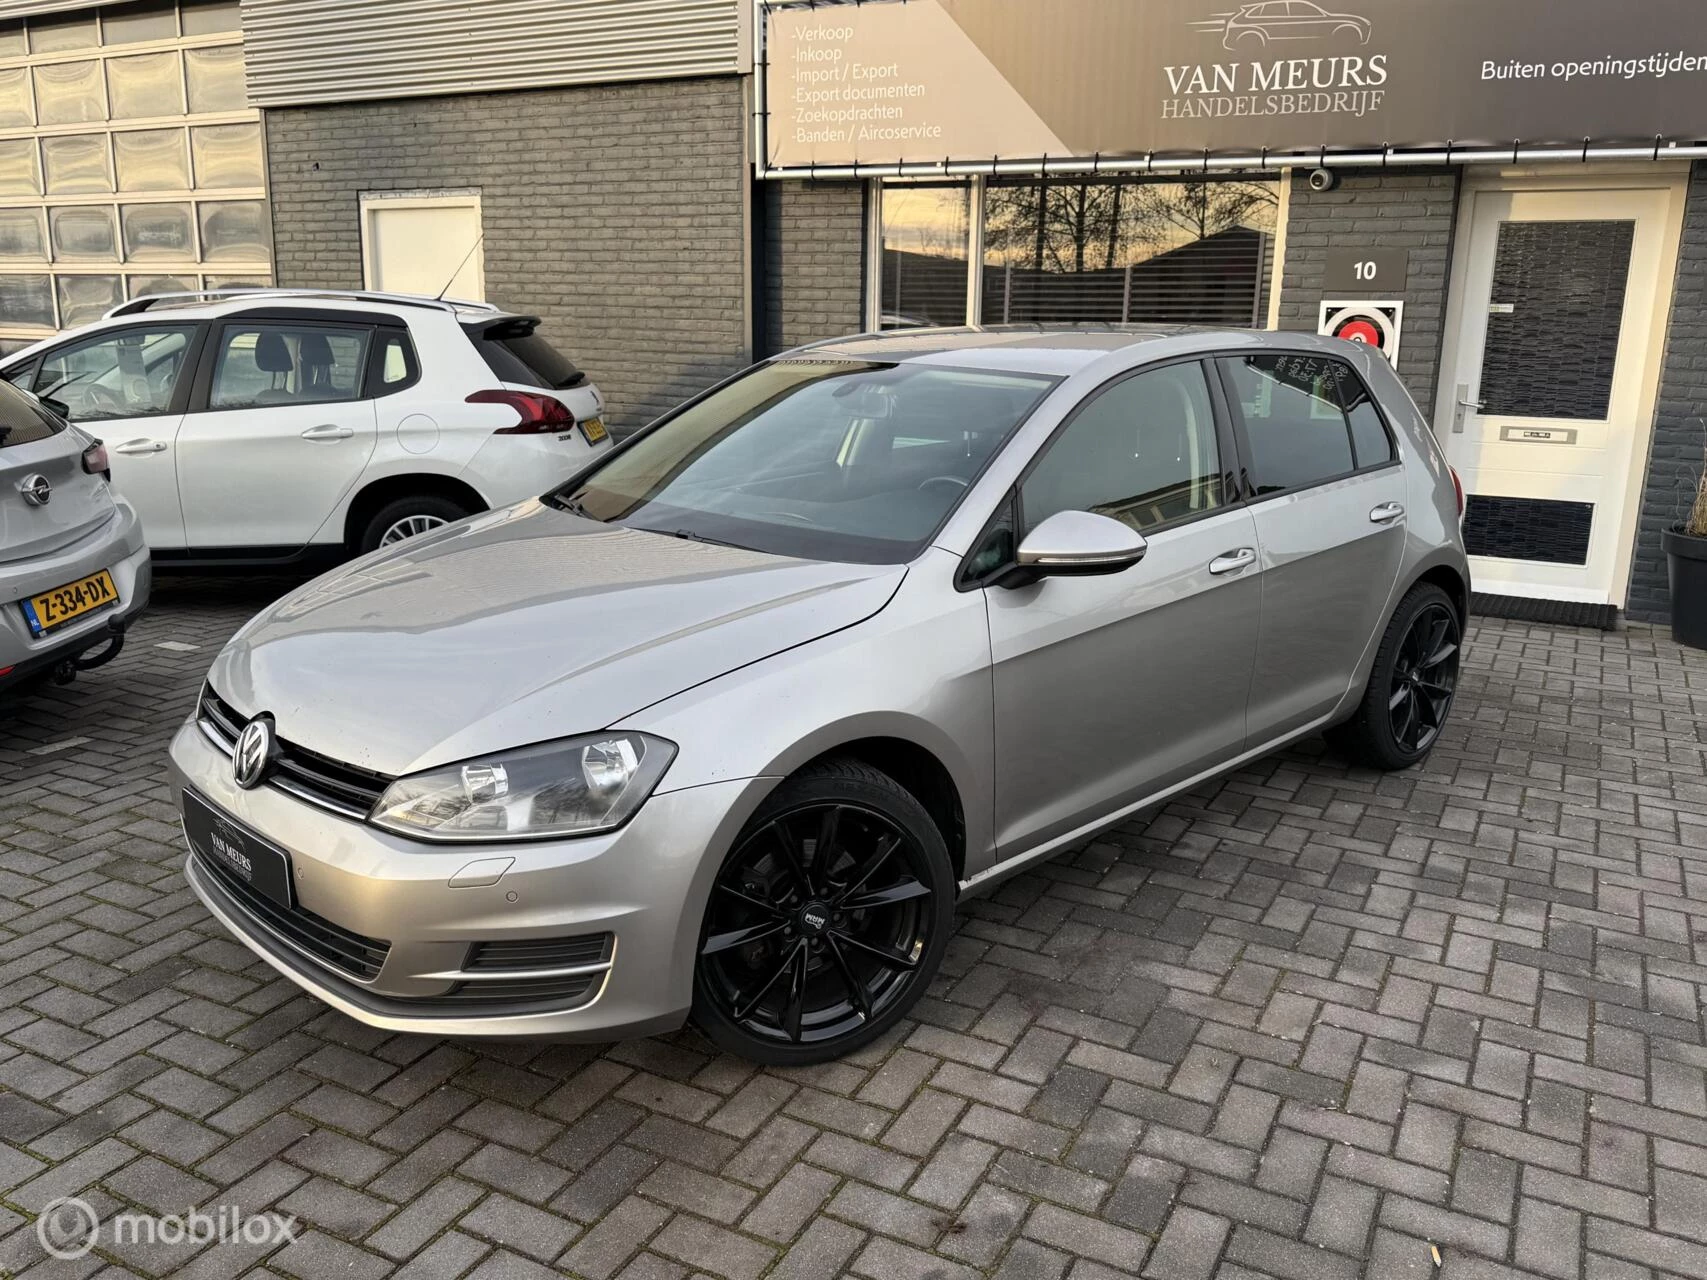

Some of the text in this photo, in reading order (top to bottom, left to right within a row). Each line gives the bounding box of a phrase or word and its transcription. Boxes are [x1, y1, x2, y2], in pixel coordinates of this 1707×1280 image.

[792, 23, 854, 43] -Verkoop
[842, 63, 849, 82] /
[853, 63, 898, 82] Export
[1163, 54, 1388, 95] VAN MEURS
[1481, 50, 1707, 81] Buiten openingstijden
[842, 83, 925, 101] documenten
[1160, 90, 1386, 119] HANDELSBEDRIJF
[847, 124, 856, 143] /
[858, 121, 942, 141] Aircoservice
[1353, 261, 1377, 280] 10
[40, 576, 111, 622] Z-334-DX
[211, 832, 226, 853] VAN
[225, 842, 252, 872] MEURS
